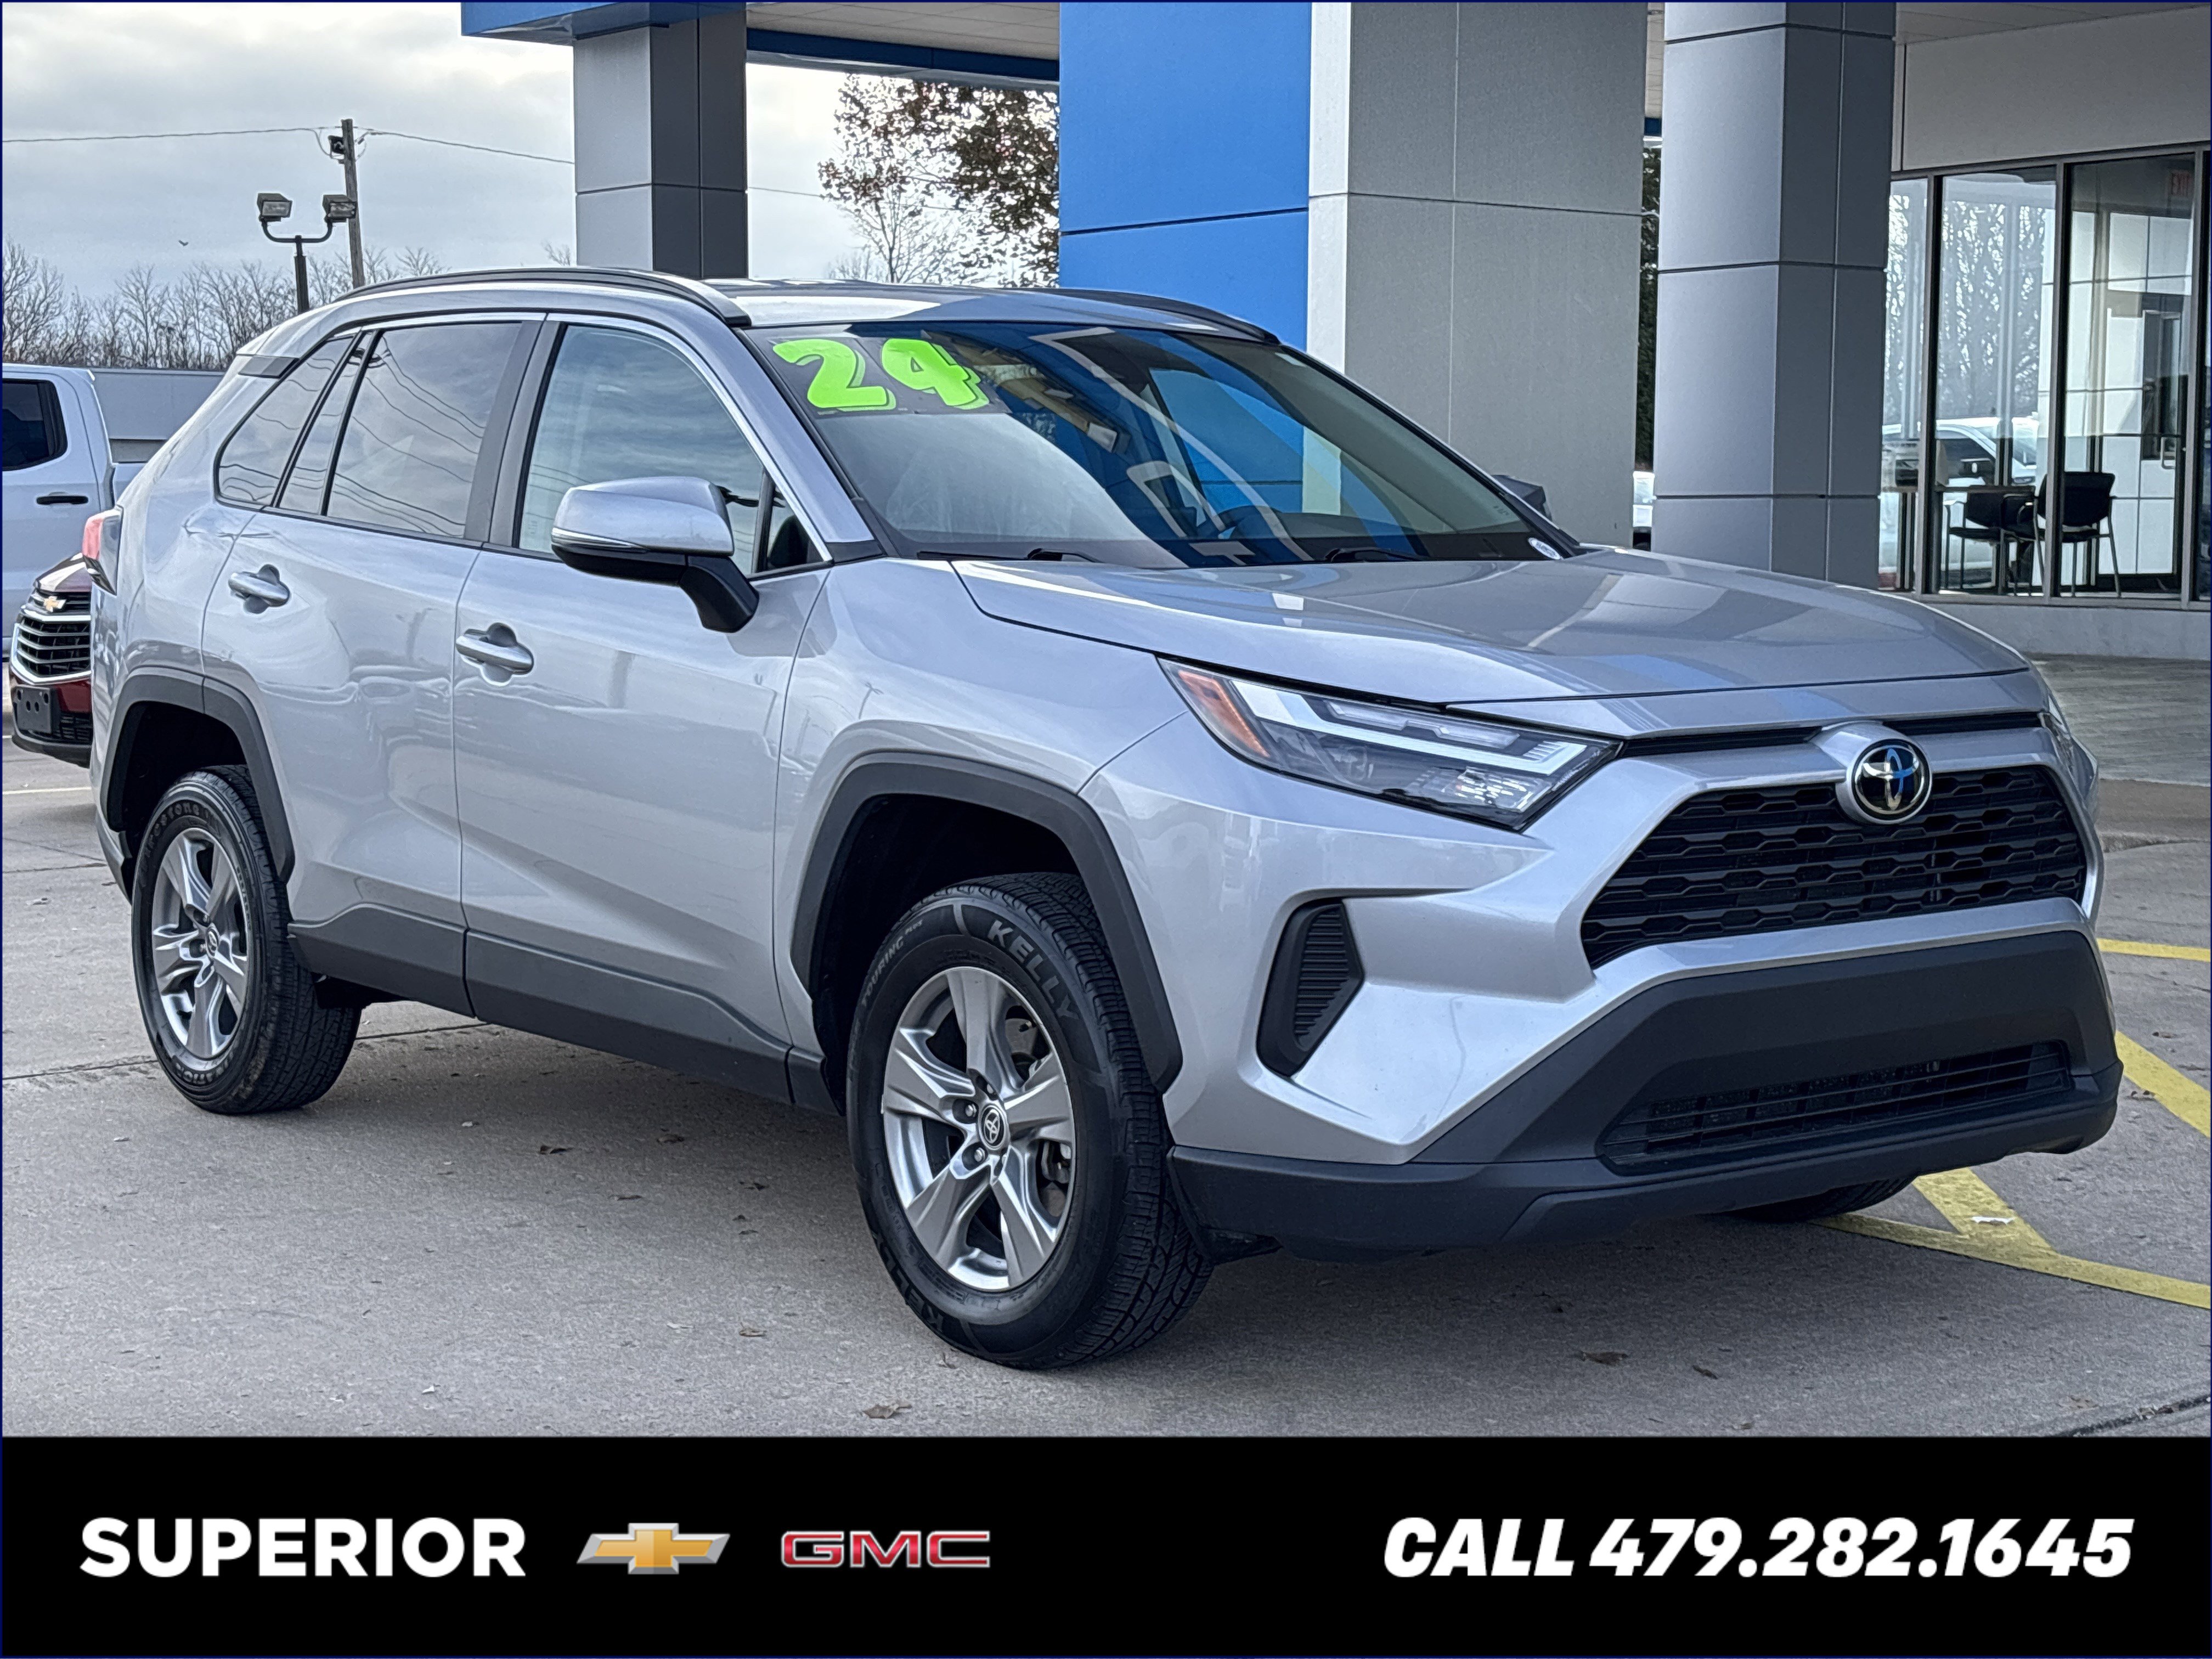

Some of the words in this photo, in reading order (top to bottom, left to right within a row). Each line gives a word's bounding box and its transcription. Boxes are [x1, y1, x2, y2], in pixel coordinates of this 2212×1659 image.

[772, 338, 989, 411] 24
[861, 934, 905, 1007] TOURING
[987, 919, 1080, 1020] KELLY
